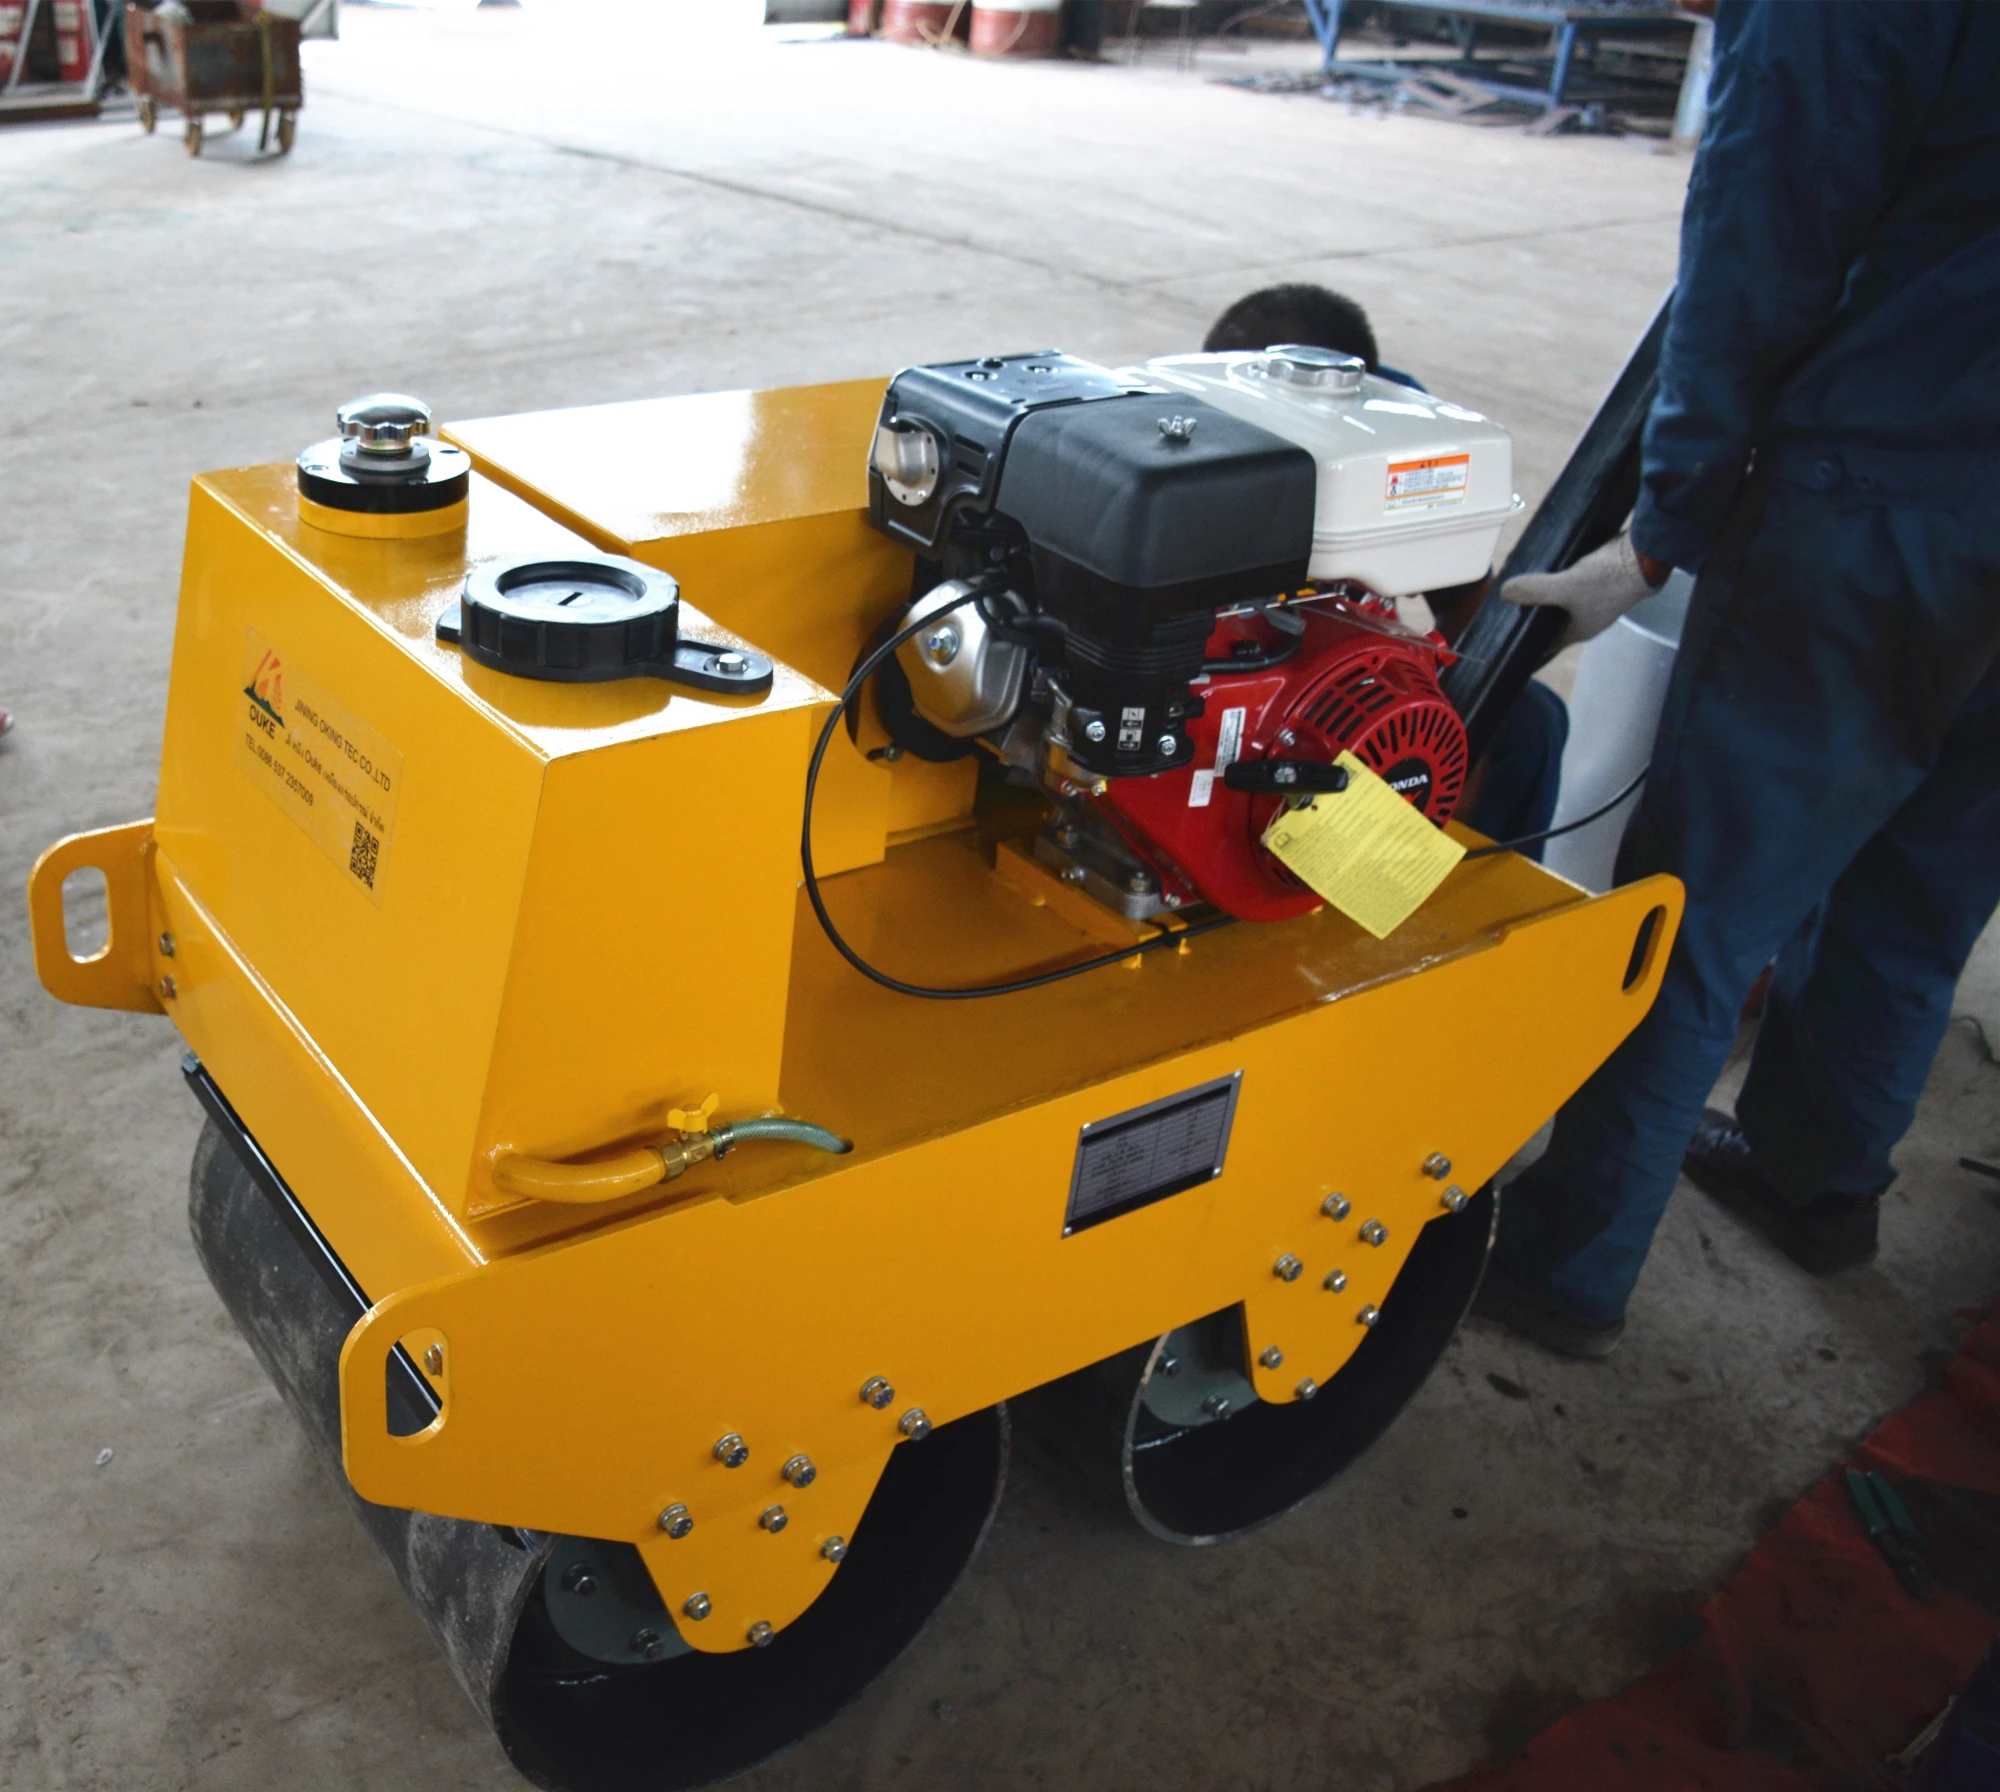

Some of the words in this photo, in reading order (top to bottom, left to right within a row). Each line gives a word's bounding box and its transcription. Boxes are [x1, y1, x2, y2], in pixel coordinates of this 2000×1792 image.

[249, 704, 276, 740] OUKE
[295, 699, 319, 727] JINING
[319, 719, 343, 749] OKING
[344, 739, 359, 763] TEC
[1389, 774, 1429, 791] ONDA
